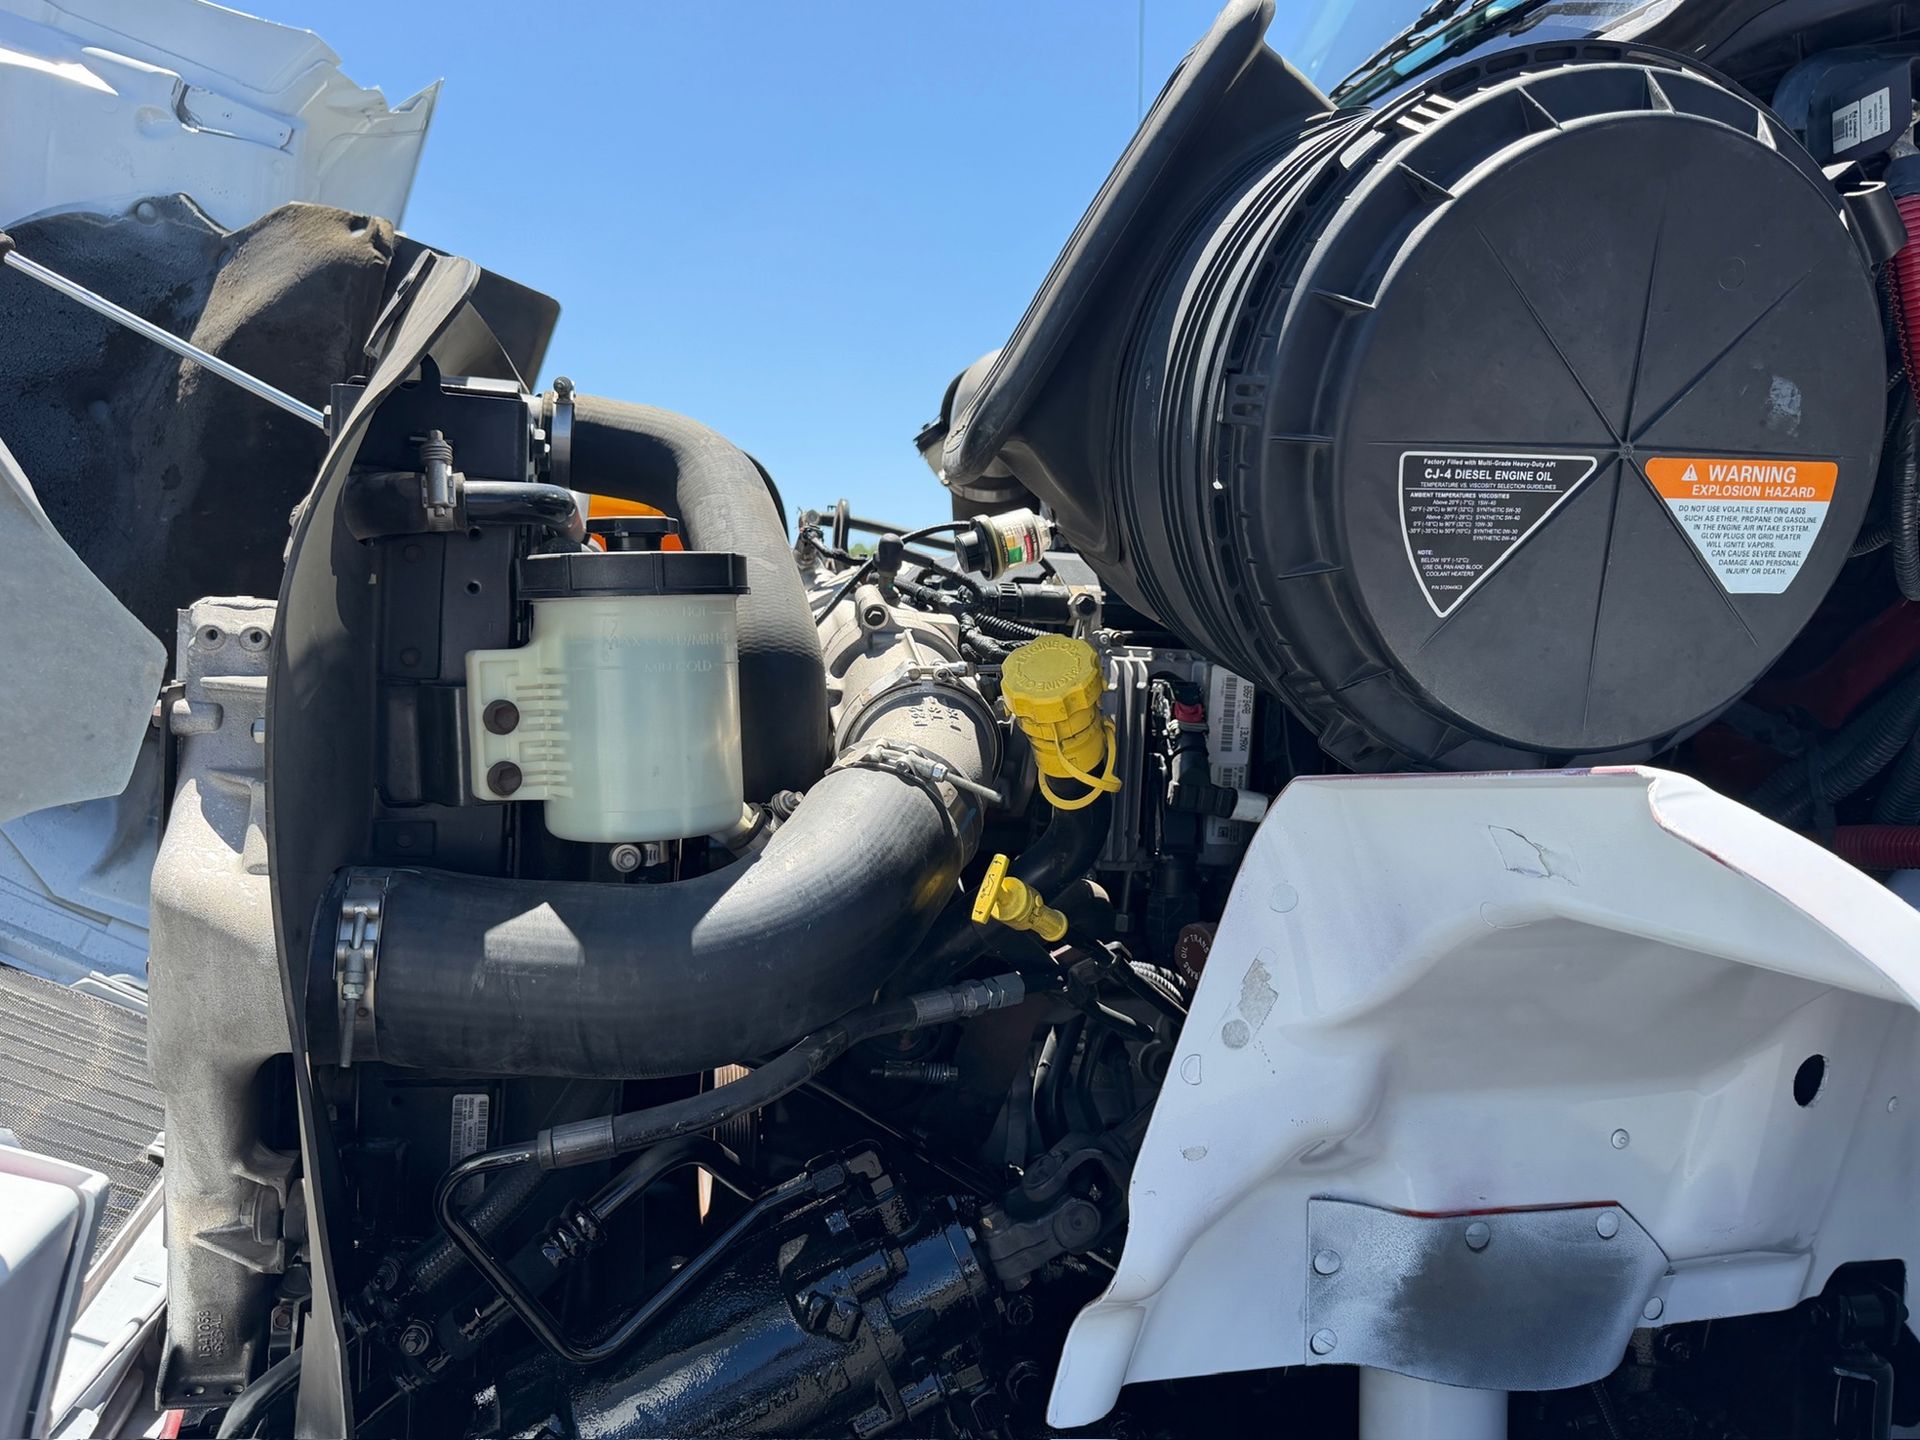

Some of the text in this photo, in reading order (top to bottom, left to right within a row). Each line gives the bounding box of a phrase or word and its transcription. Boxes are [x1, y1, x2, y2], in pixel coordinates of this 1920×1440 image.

[1423, 458, 1445, 466] Factory
[1477, 459, 1511, 467] Multi-Grade
[1512, 460, 1545, 468] Heavy-Duty
[1424, 468, 1553, 482] CJ-4 DIESEL ENGINE OIL
[1708, 464, 1797, 484] WARNING
[1692, 484, 1816, 498] EXPLOSION HAZARD
[1755, 506, 1789, 514] STARTING
[1790, 507, 1807, 515] AIDS
[1784, 516, 1817, 524] GASOLINE
[1700, 532, 1722, 540] GLOW
[1776, 533, 1801, 541] HEATER
[1723, 541, 1745, 549] IGNITE
[1727, 550, 1750, 558] CAUSE
[1751, 550, 1776, 558] SEVERE
[1777, 551, 1802, 559] ENGINE
[1718, 559, 1748, 567] DAMAGE
[1016, 640, 1060, 665] ENGINE
[1189, 933, 1210, 954] TRANS
[1180, 946, 1189, 959] OIL
